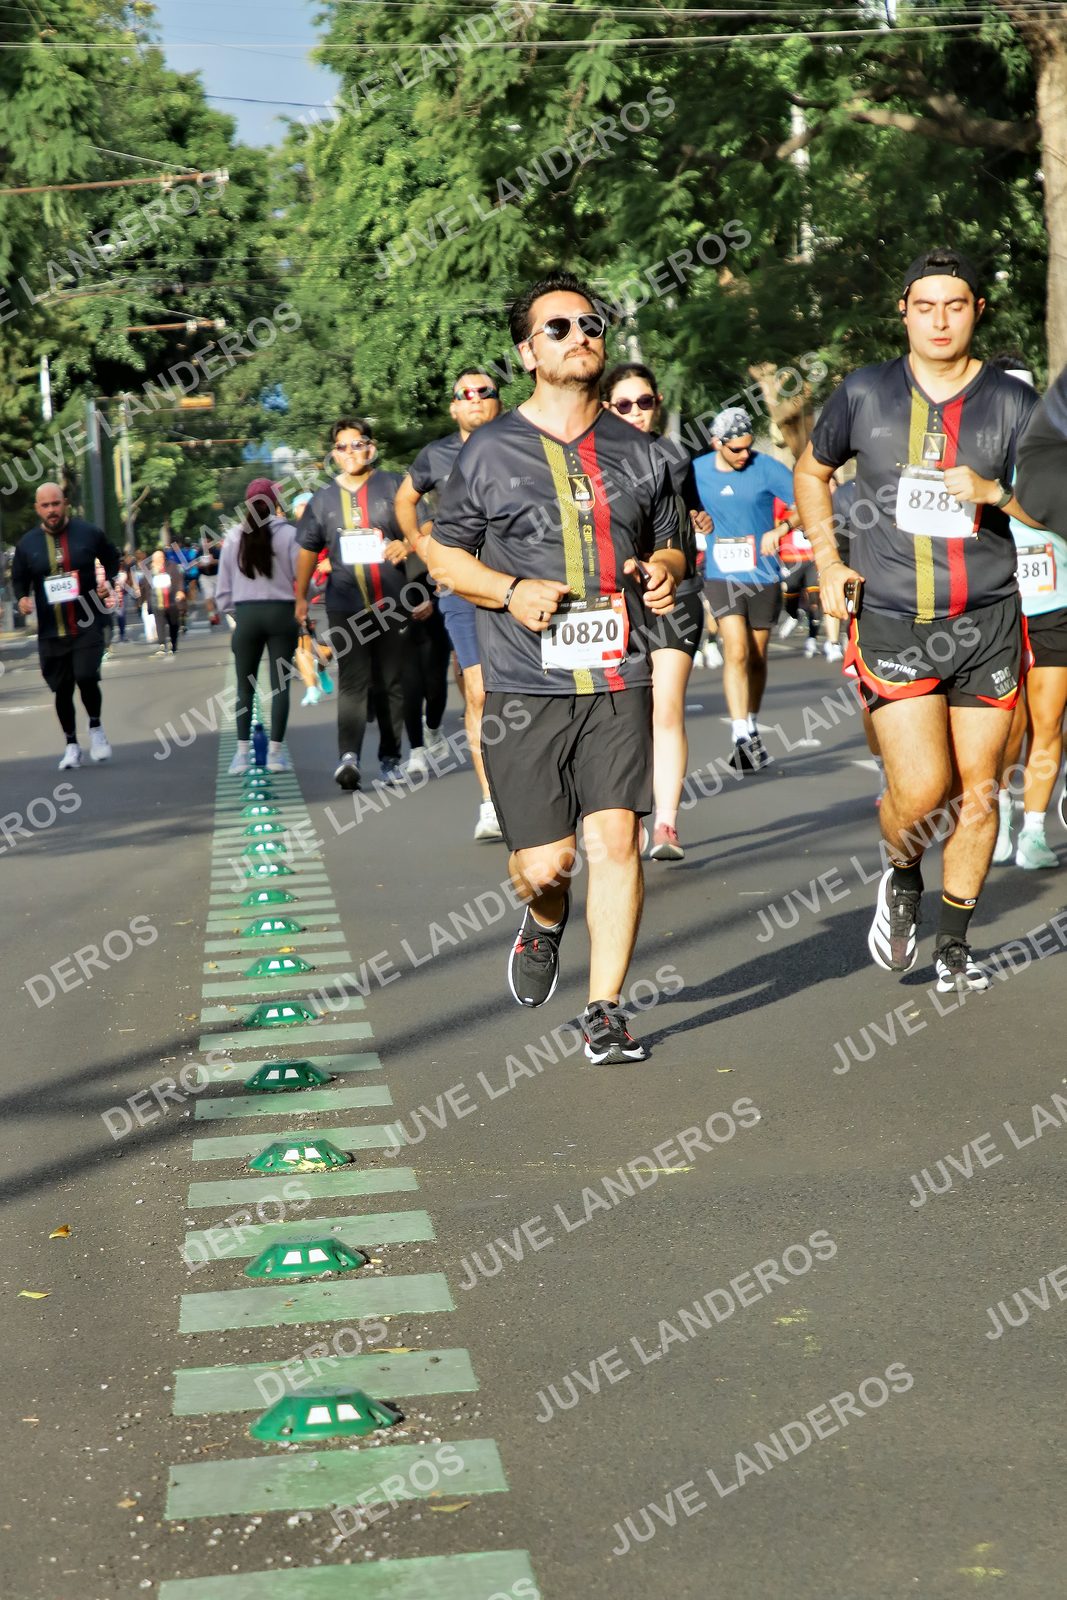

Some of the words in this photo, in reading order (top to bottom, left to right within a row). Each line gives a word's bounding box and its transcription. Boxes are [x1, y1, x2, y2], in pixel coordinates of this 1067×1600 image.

[1013, 561, 1048, 579] 381
[547, 619, 618, 647] 10820
[877, 659, 918, 676] TOPTIME
